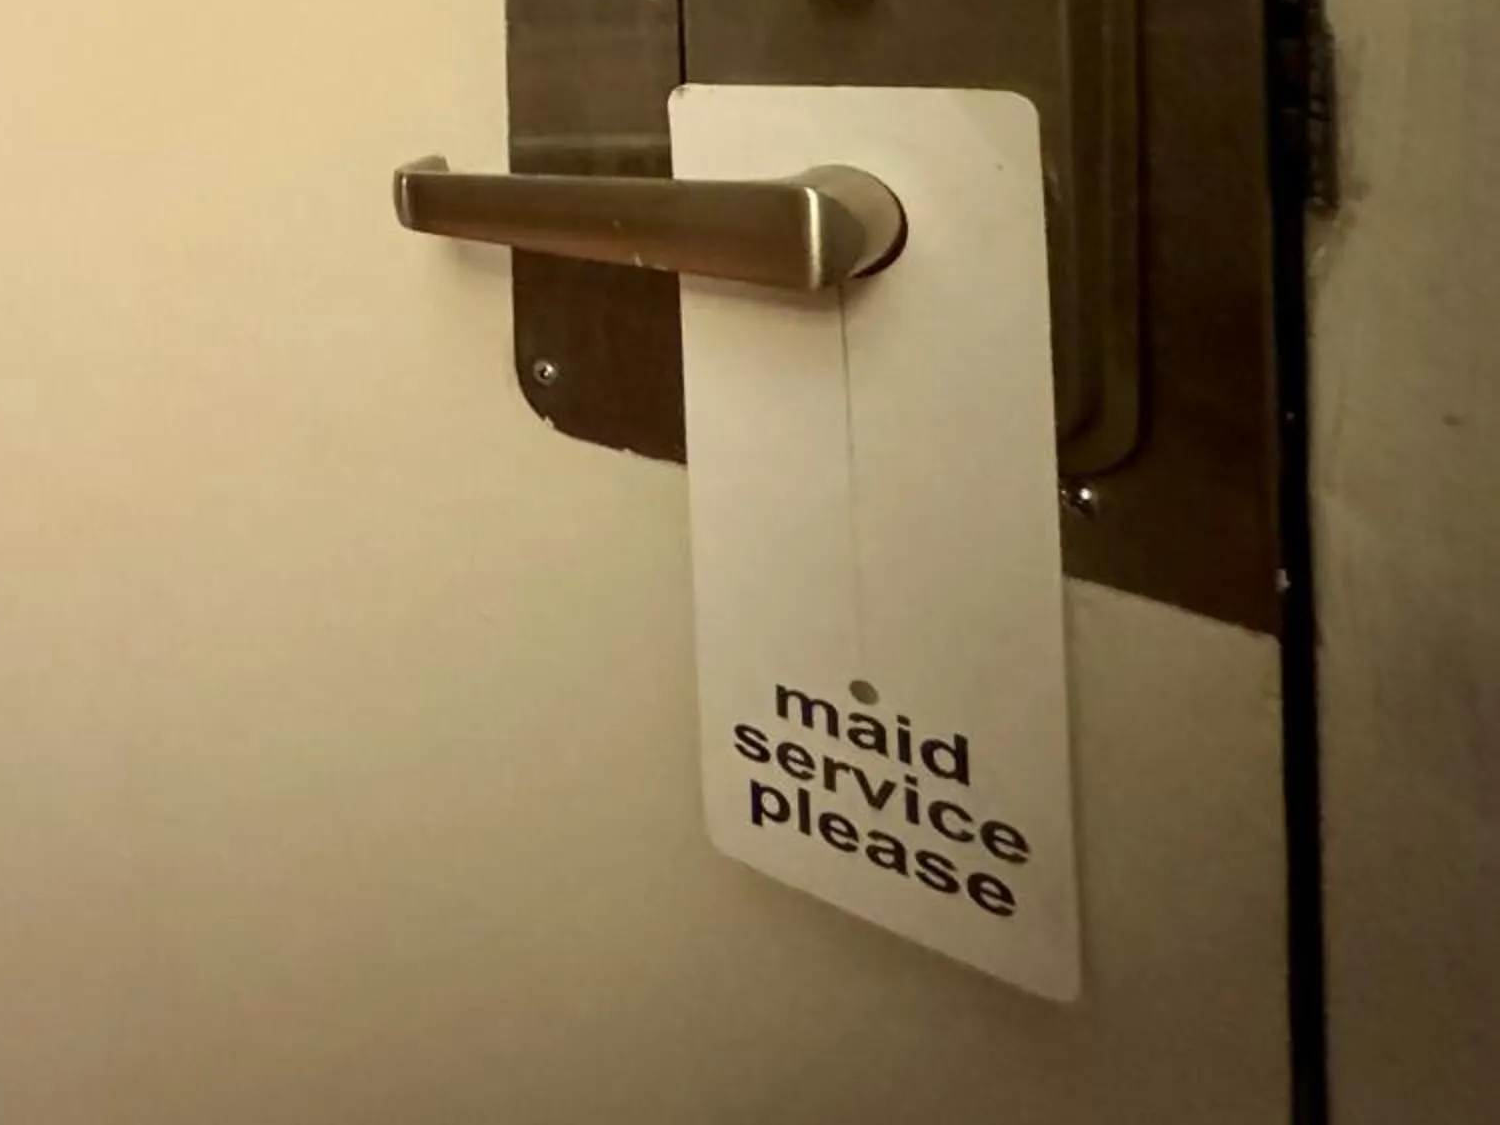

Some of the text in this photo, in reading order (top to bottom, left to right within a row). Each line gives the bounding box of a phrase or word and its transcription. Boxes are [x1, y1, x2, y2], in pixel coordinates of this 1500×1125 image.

[733, 723, 1031, 864] service
[775, 683, 970, 786] maid
[749, 778, 1017, 917] please
